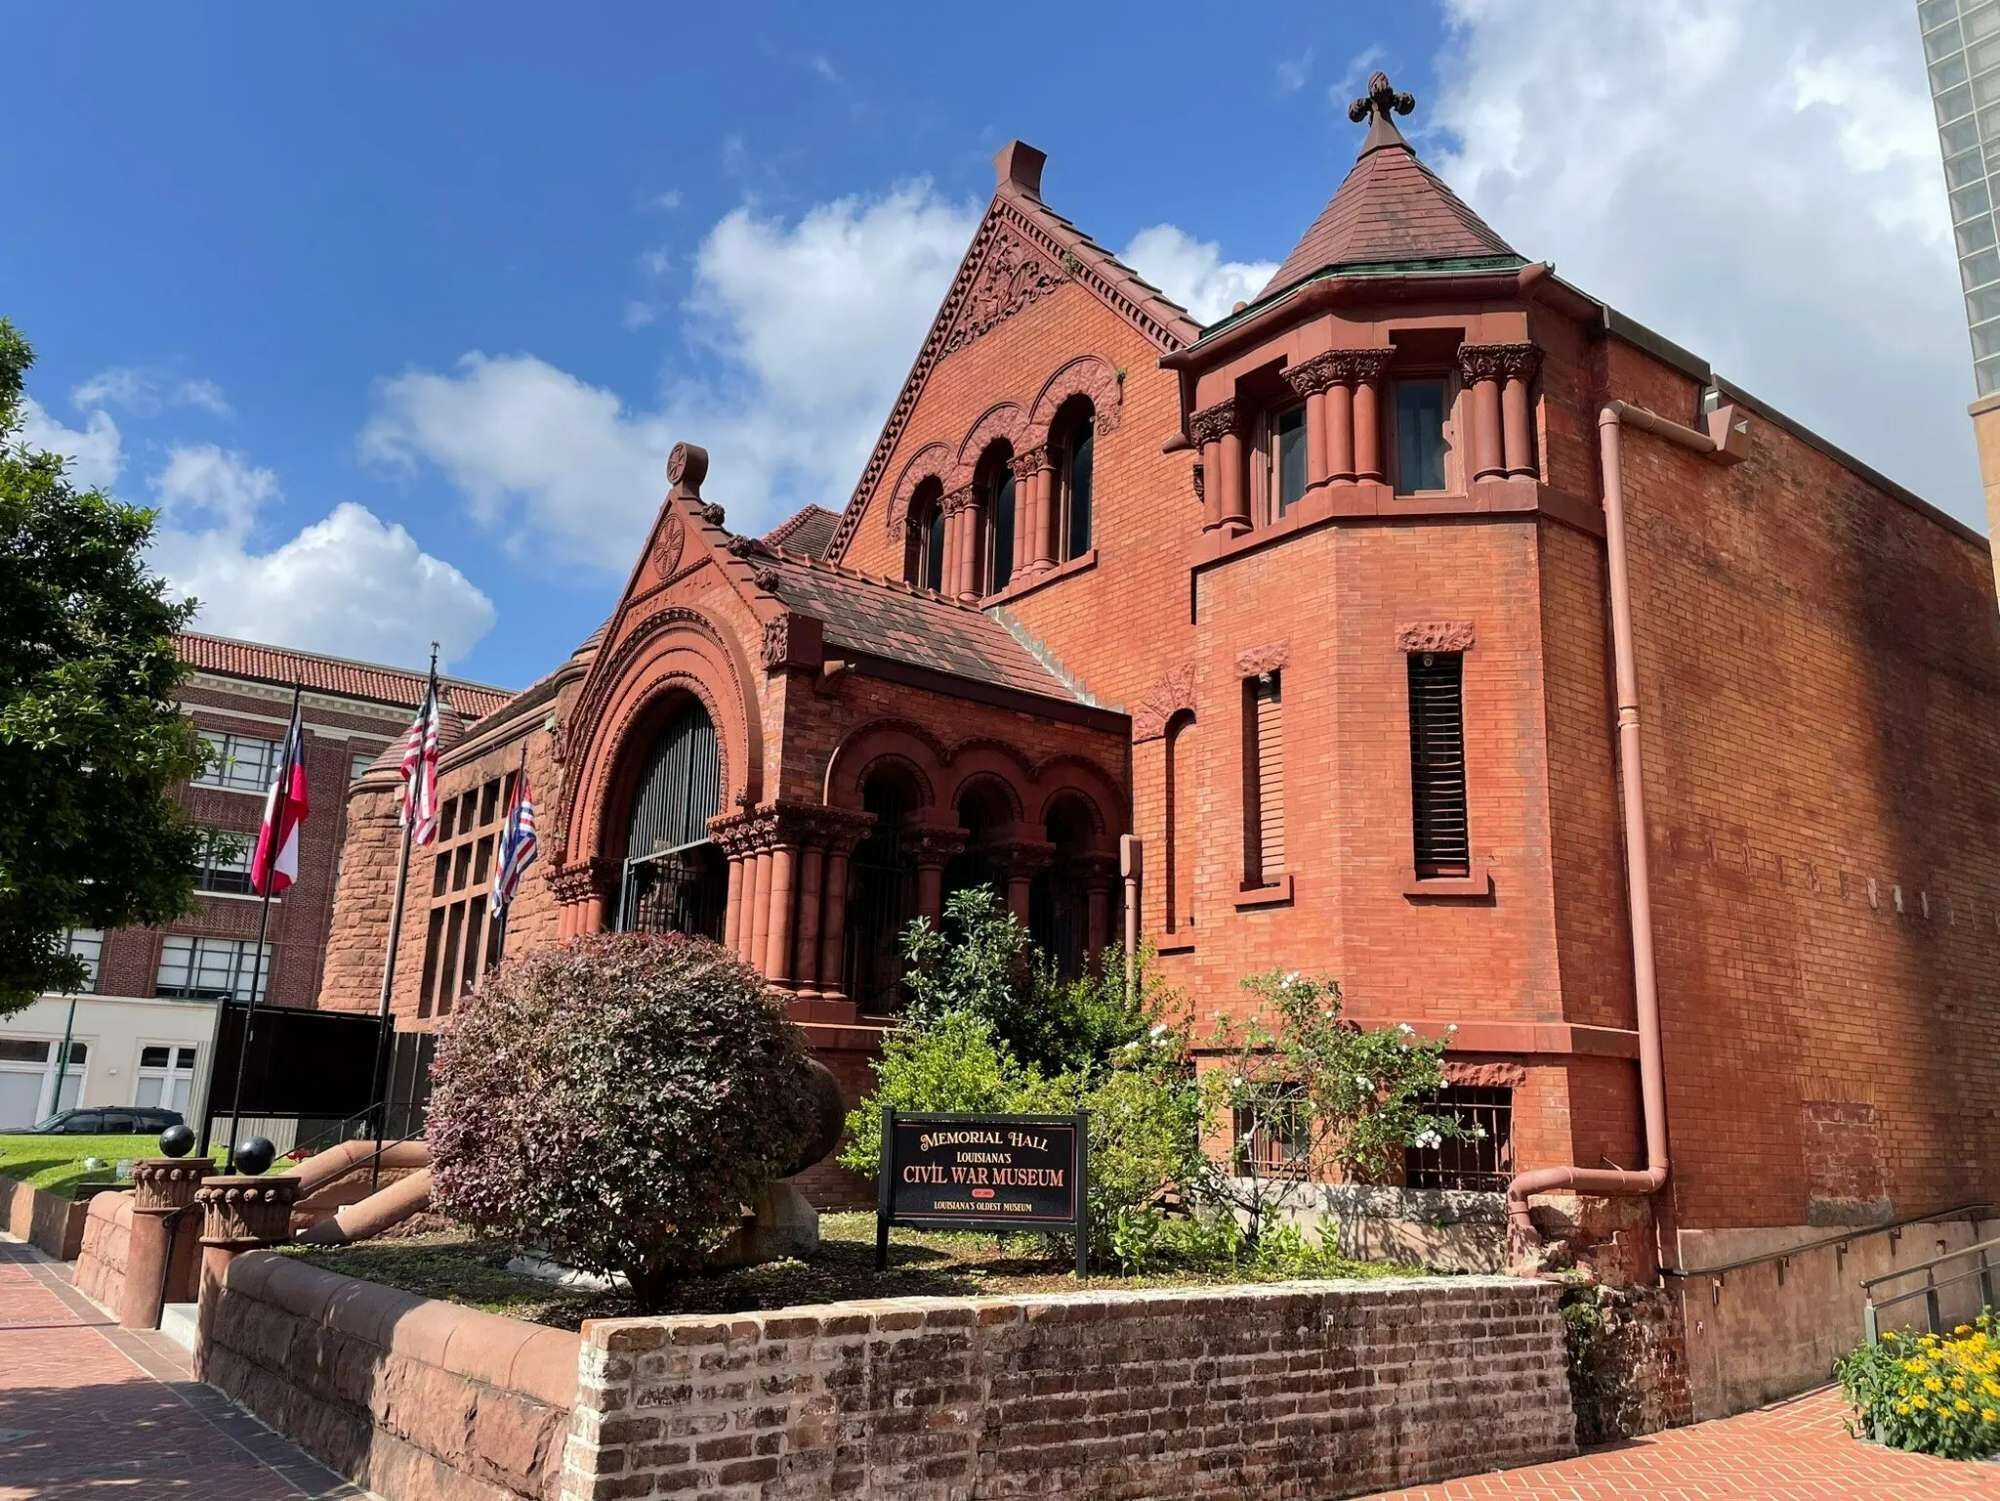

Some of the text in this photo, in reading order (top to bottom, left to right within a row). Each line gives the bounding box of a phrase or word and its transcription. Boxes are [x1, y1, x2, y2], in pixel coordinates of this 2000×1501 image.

[920, 1132, 1048, 1151] MEMORIAL HALL
[957, 1152, 1012, 1164] LOUISIANA'S
[903, 1162, 1063, 1187] CIVIL WAR MUSEUM
[934, 1201, 1032, 1211] LOUISIANA'S OLDEST MUSEUM
